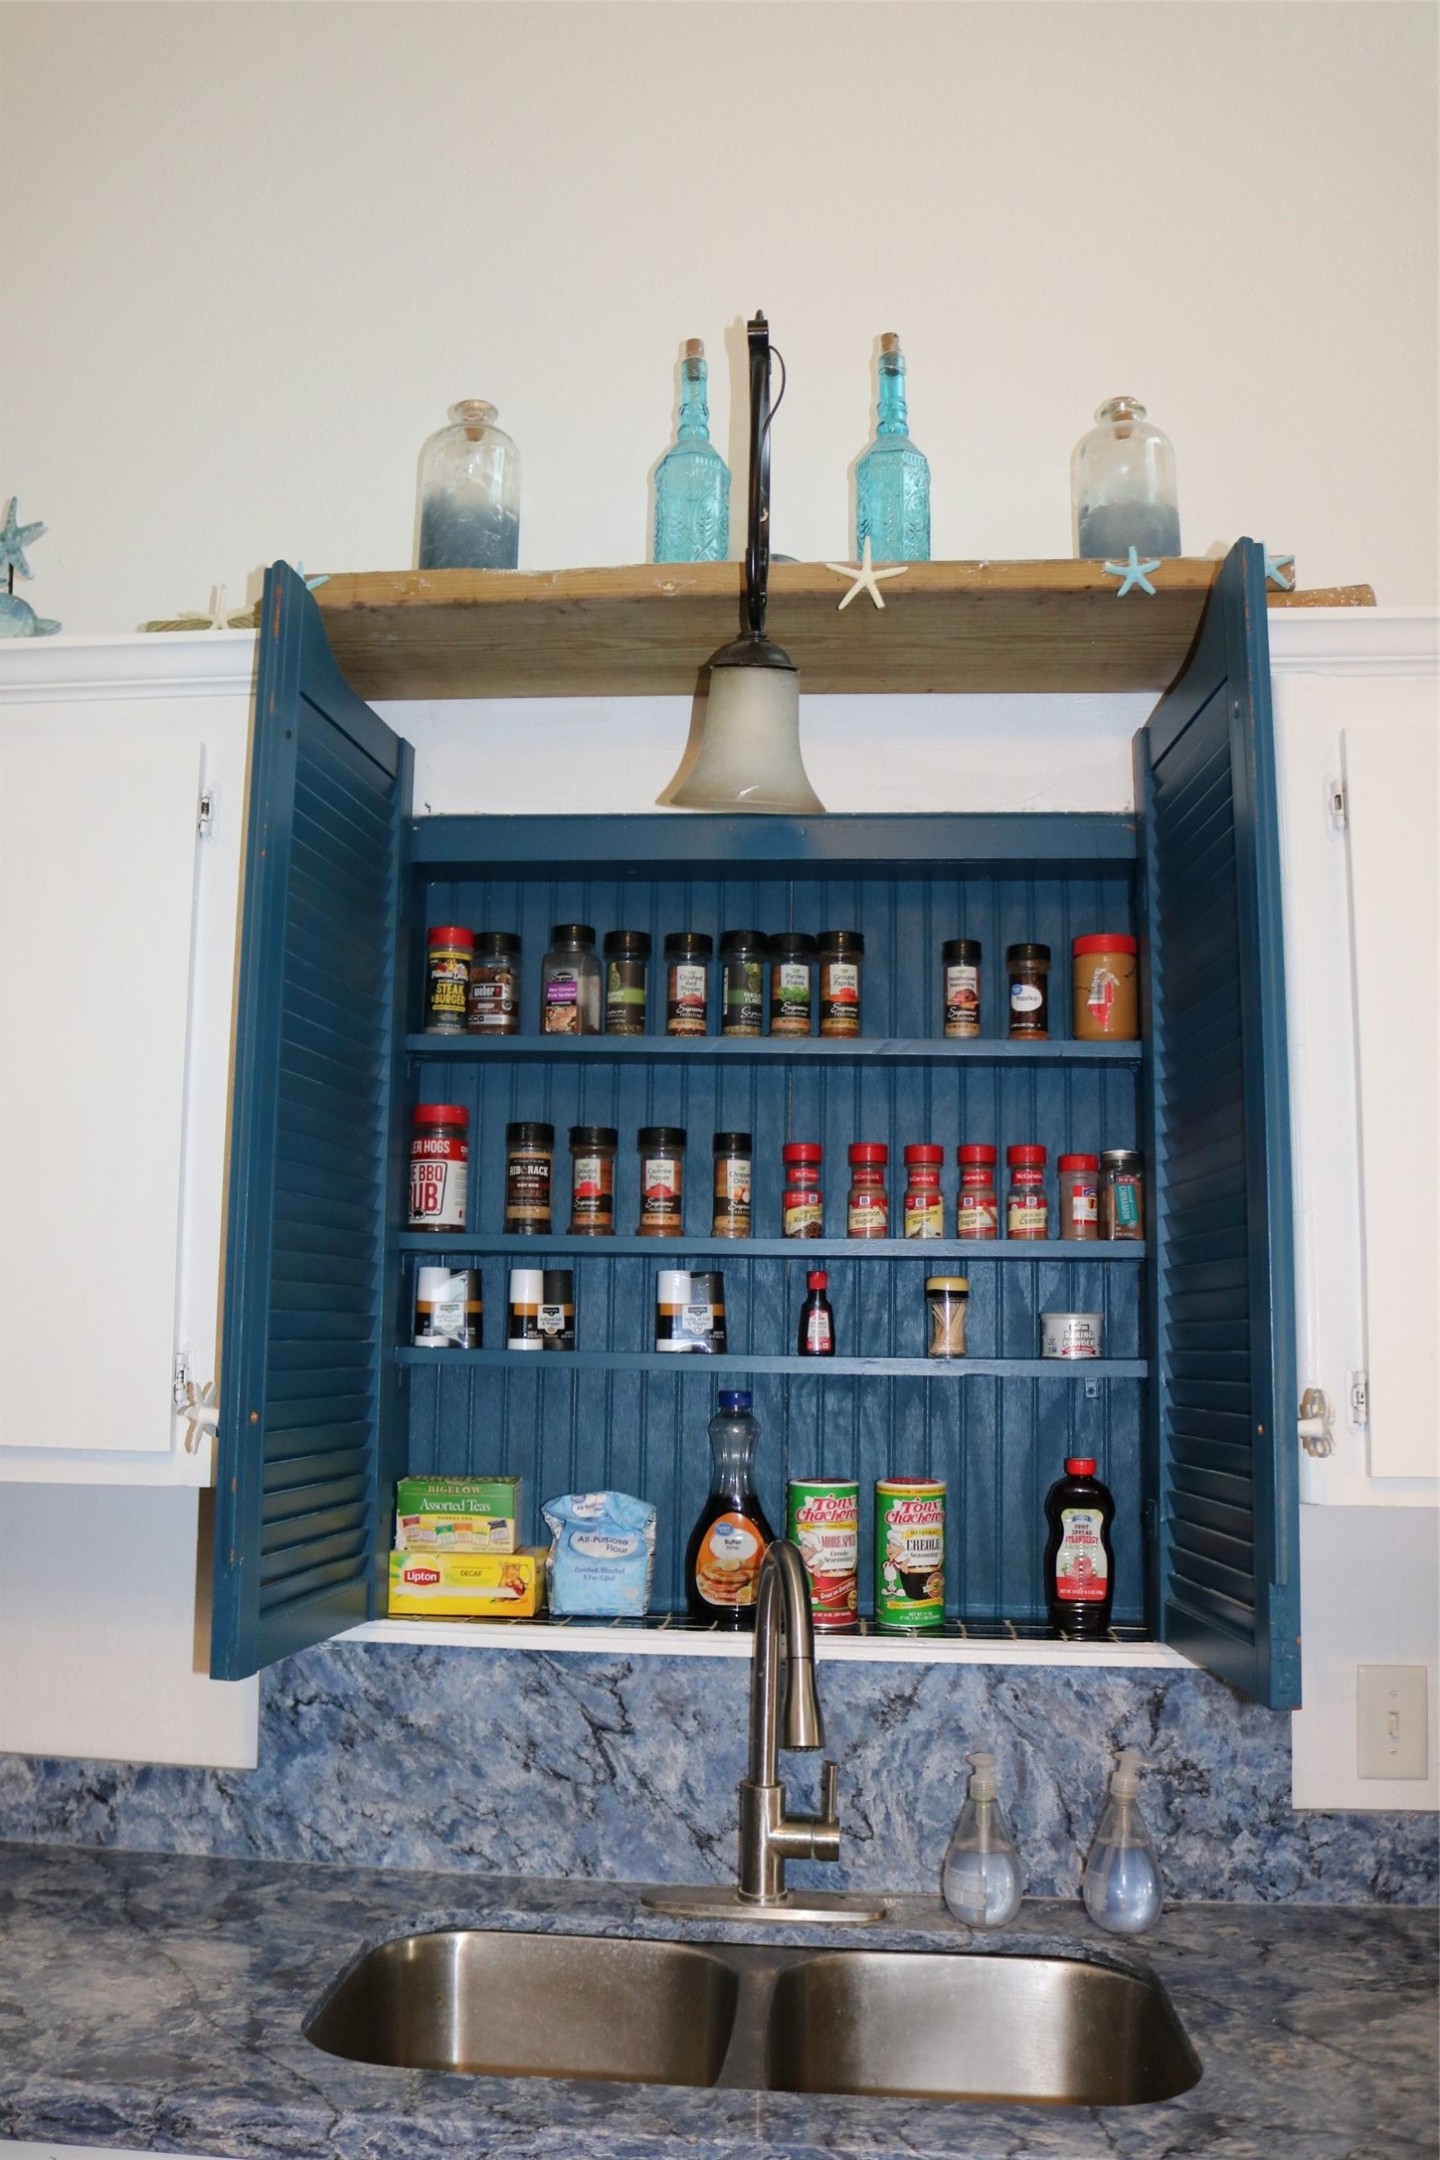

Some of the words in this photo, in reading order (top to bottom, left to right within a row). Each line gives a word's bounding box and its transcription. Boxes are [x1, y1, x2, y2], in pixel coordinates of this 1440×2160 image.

[436, 983, 465, 994] STEAK
[474, 985, 495, 997] weber
[435, 994, 466, 1006] BURGER
[424, 1140, 450, 1154] HOGS
[419, 1165, 443, 1182] BBQ
[509, 1165, 521, 1177] RIB
[527, 1165, 549, 1177] RACK
[1118, 1185, 1131, 1219] CINNAMON
[1019, 1217, 1043, 1225] Cumin
[427, 1485, 482, 1494] BIGELOW
[420, 1498, 465, 1512] Assorted
[467, 1500, 491, 1512] Teas
[578, 1535, 629, 1546] All-Purpose
[821, 1535, 841, 1548] MORE
[906, 1538, 941, 1551] CREOLE
[606, 1545, 629, 1554] Flour
[406, 1571, 437, 1583] Lipton
